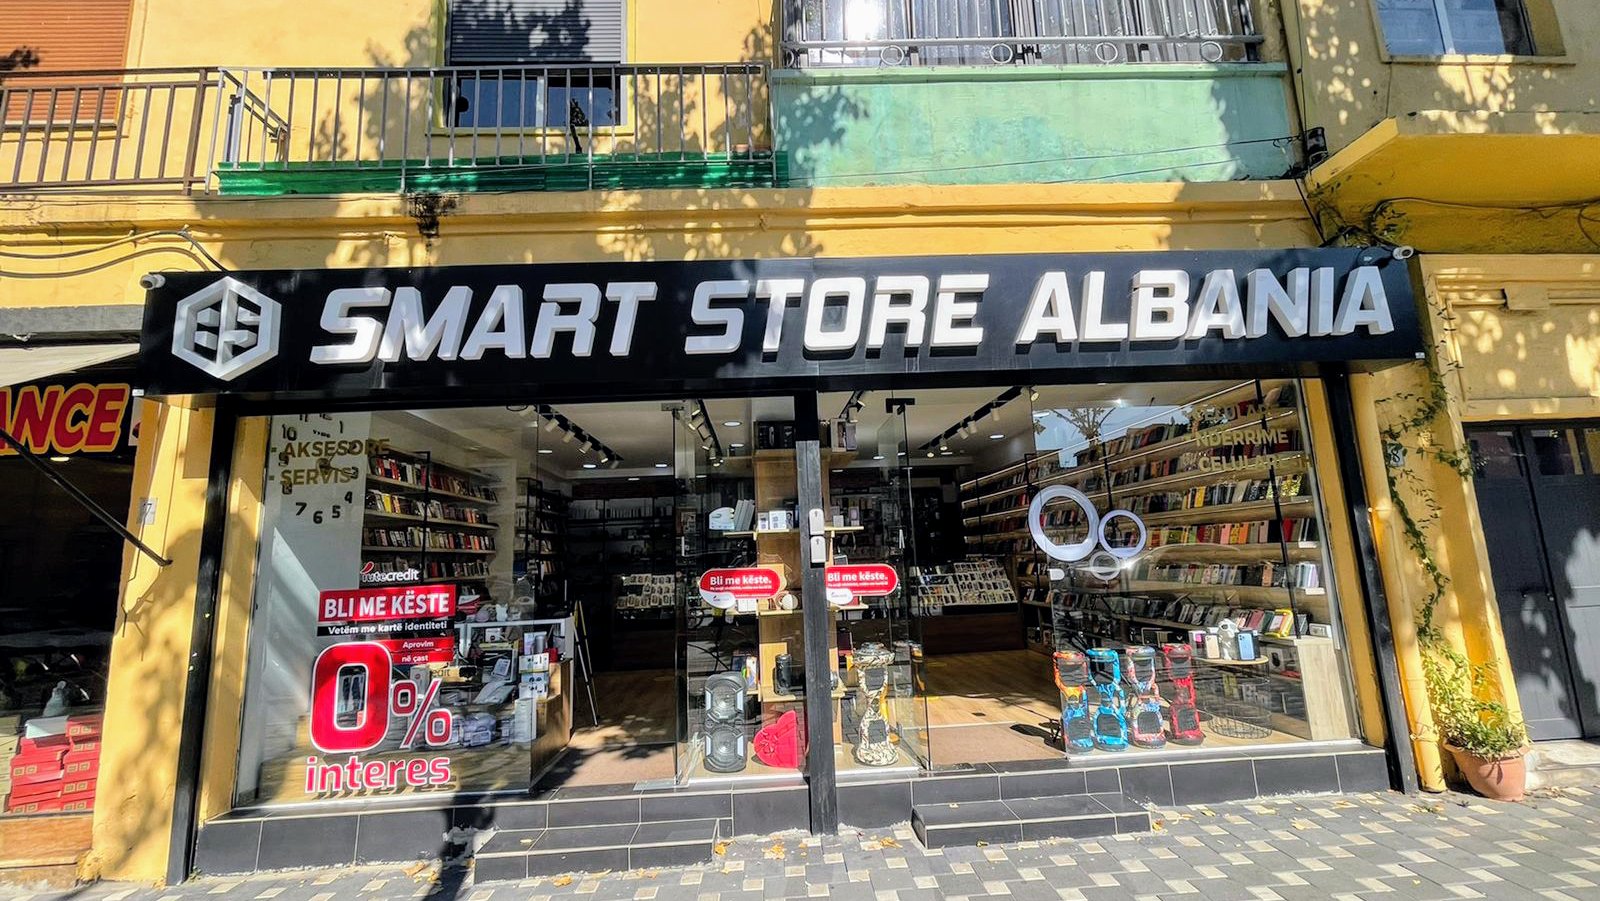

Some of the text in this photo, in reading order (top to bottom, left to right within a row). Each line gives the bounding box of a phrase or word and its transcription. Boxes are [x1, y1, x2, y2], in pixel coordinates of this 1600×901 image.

[309, 266, 1394, 364] SMART STORE ALBANIA
[284, 438, 390, 458] AKSESORE
[280, 467, 352, 485] SERVIS
[295, 502, 307, 516] 7
[332, 505, 341, 519] 5
[313, 511, 323, 524] 6
[710, 574, 772, 585] Bli me këste.
[827, 571, 888, 582] Bli me këste.
[324, 590, 450, 618] BLI ME KËSTE
[328, 624, 359, 635] Vetëm
[378, 623, 403, 633] kartë
[404, 621, 448, 631] identiteti
[402, 640, 434, 650] Aprovim
[309, 641, 453, 753] 0%
[304, 755, 451, 793] interes
